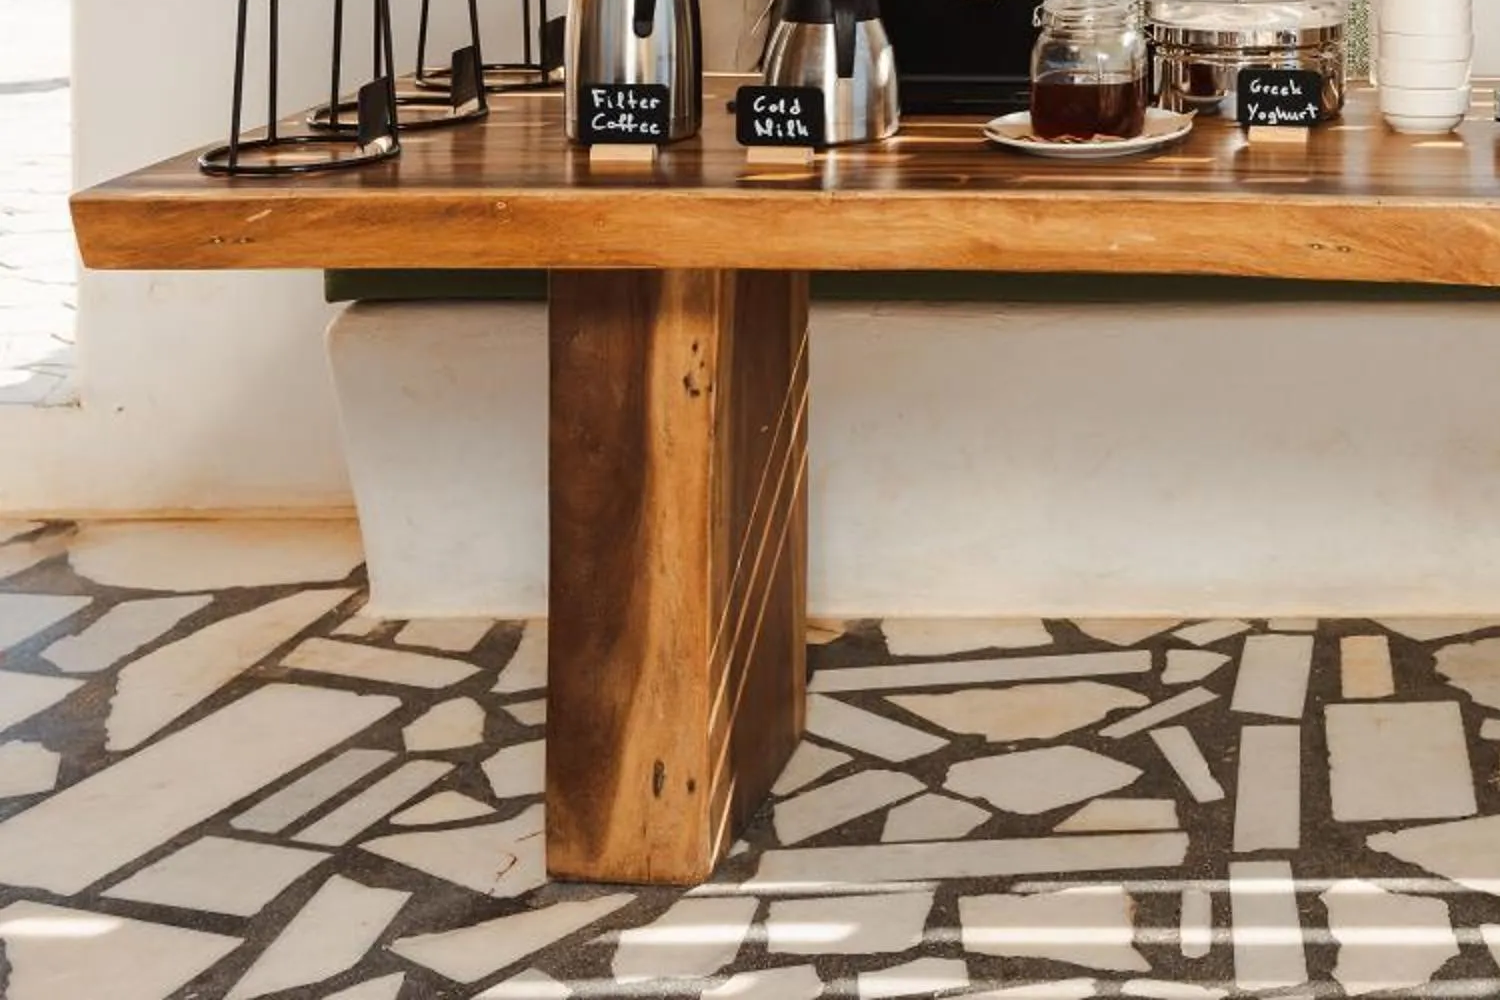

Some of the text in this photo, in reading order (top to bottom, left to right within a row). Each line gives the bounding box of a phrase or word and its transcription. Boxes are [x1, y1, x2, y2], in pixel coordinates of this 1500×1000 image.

[1250, 78, 1303, 96] Greek
[591, 88, 661, 109] Filter
[753, 95, 801, 115] Cold
[591, 112, 661, 135] Coffee
[1247, 102, 1318, 125] Yoghurt
[754, 117, 809, 137] Milk
